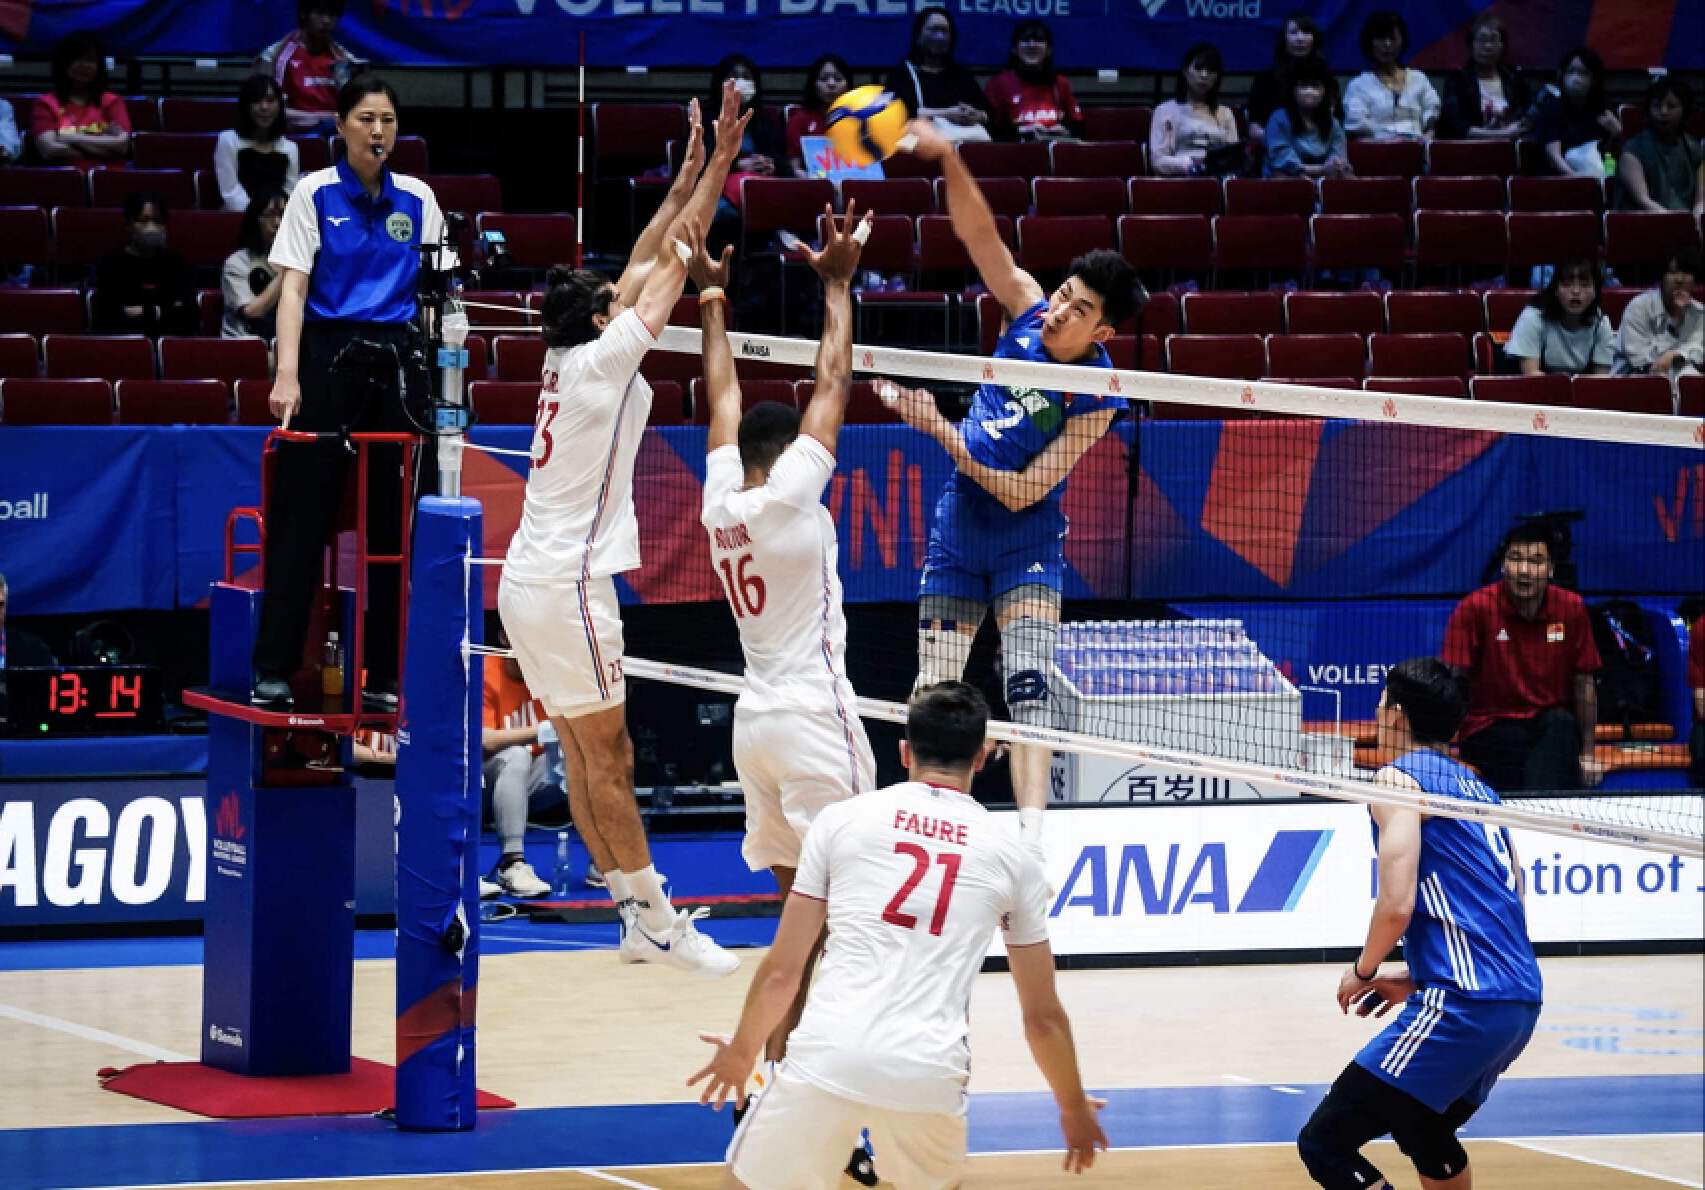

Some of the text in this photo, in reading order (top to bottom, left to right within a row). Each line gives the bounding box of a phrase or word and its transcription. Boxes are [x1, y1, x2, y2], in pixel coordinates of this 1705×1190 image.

[981, 401, 1024, 439] 2
[720, 553, 767, 618] 16
[893, 809, 968, 846] FAURE
[881, 841, 962, 937] 21
[1048, 842, 1230, 918] ANA
